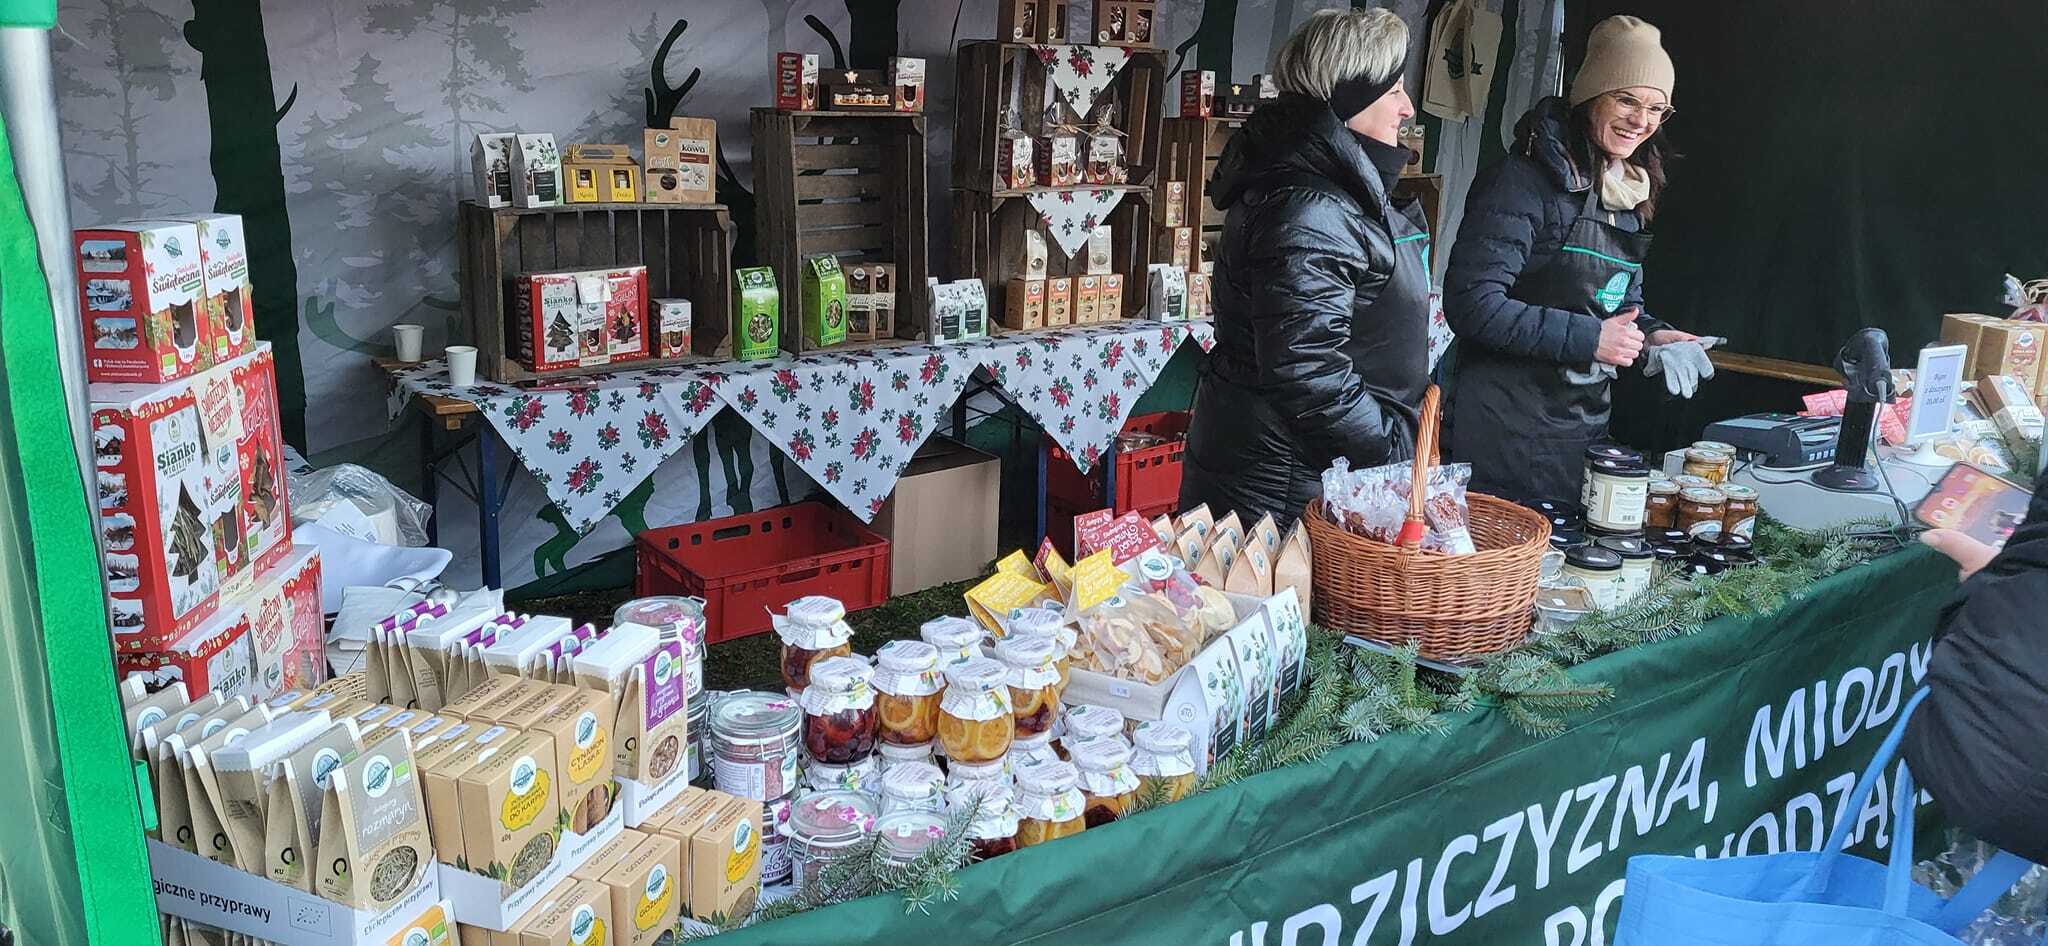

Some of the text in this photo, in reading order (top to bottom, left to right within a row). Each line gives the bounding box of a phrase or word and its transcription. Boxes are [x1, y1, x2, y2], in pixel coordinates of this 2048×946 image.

[157, 442, 196, 471] Sianko
[361, 801, 413, 841] rozmaryn
[153, 878, 271, 923] giczne przyprawy
